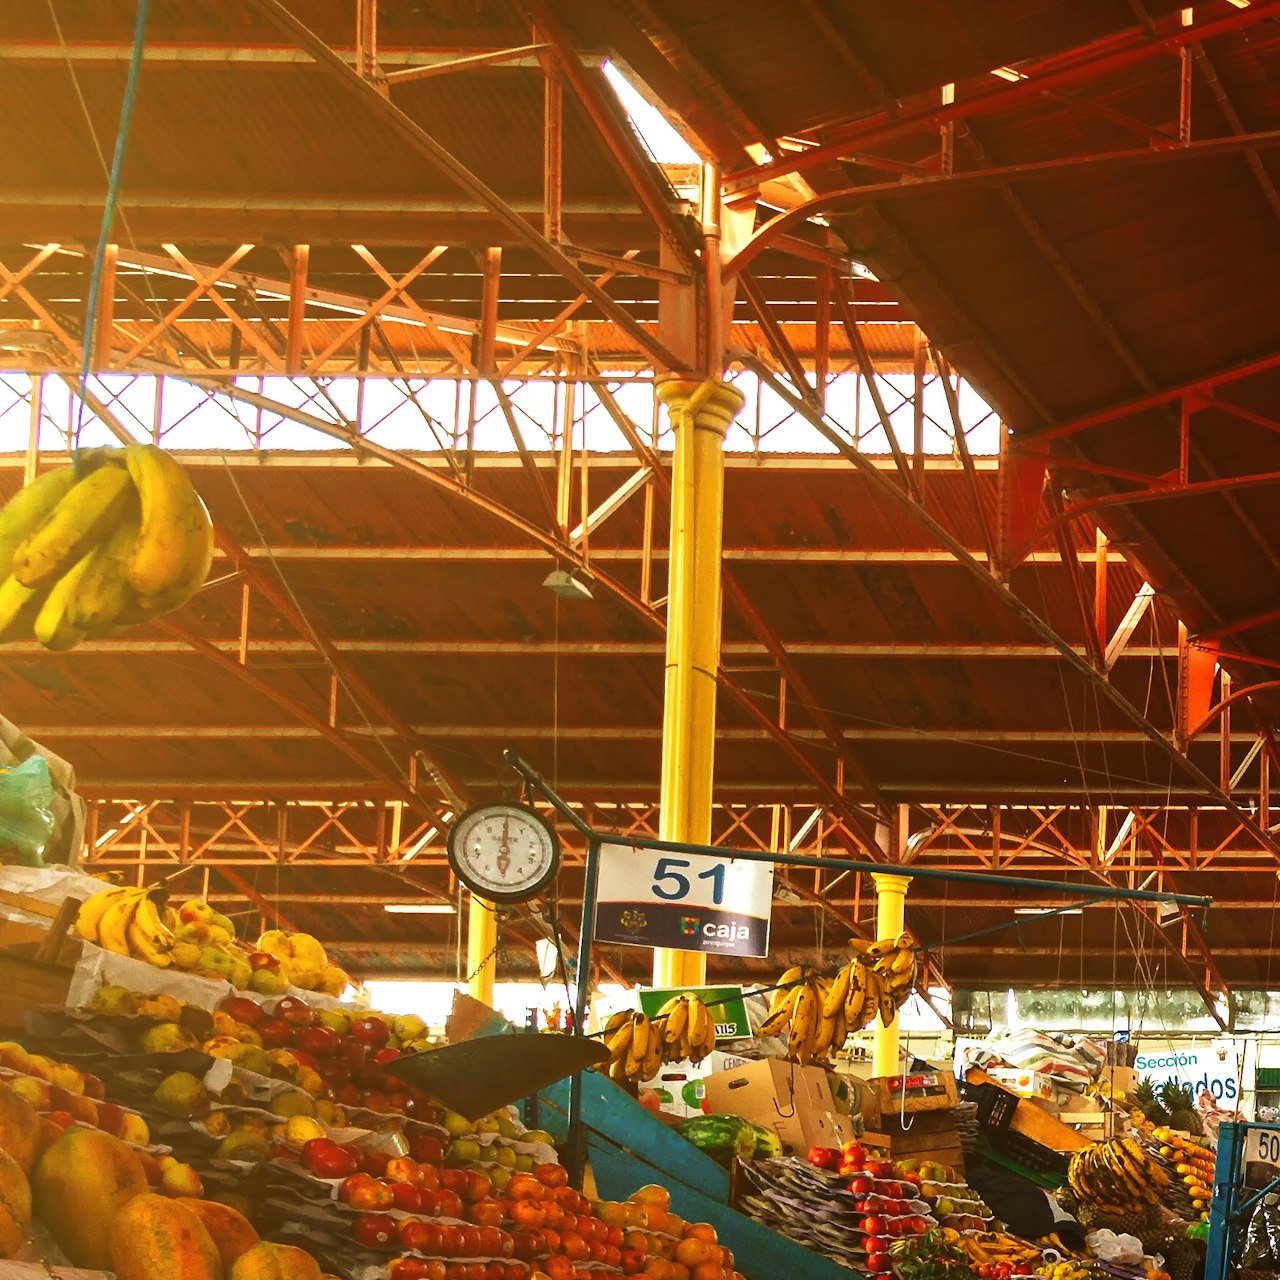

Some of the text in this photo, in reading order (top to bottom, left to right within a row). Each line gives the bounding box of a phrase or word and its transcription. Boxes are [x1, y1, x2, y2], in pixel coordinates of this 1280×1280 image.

[652, 858, 726, 905] 51
[703, 921, 750, 942] caja
[1136, 1052, 1198, 1070] Sección
[1259, 1132, 1280, 1162] 50
